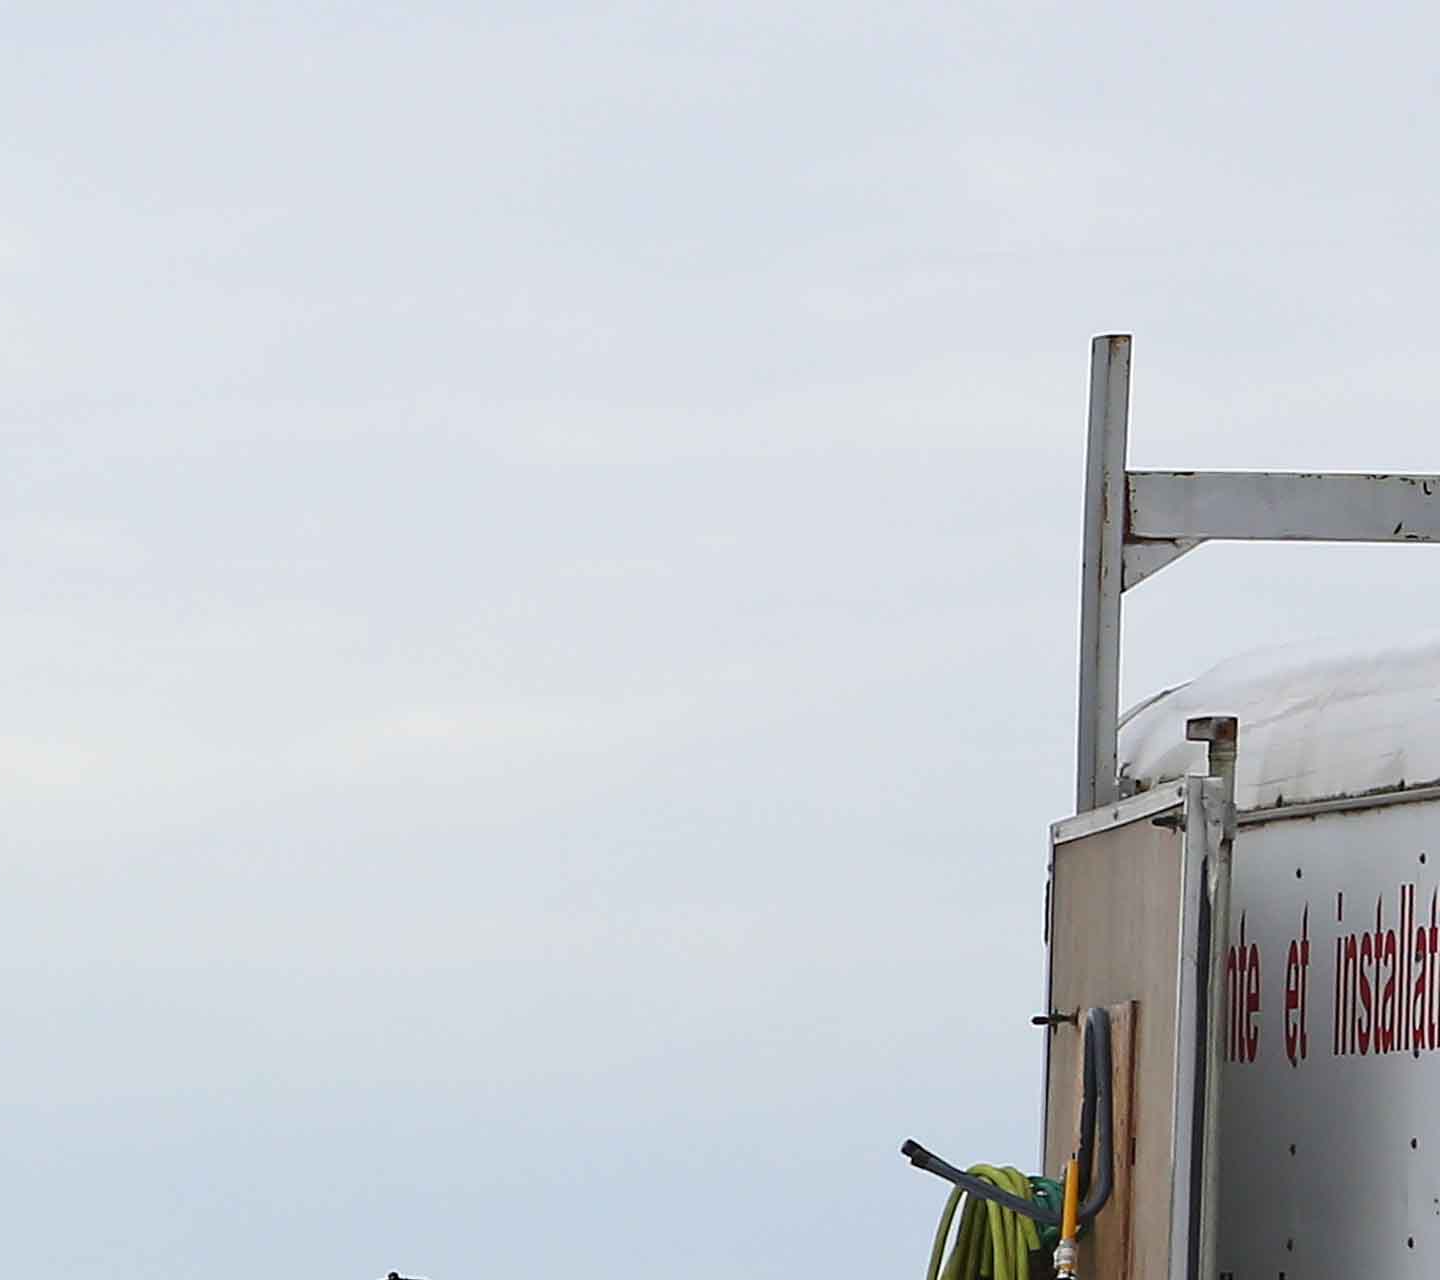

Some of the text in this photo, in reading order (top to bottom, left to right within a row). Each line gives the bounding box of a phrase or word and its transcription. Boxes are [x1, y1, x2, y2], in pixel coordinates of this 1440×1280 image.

[1224, 884, 1440, 1063] nte et installat
